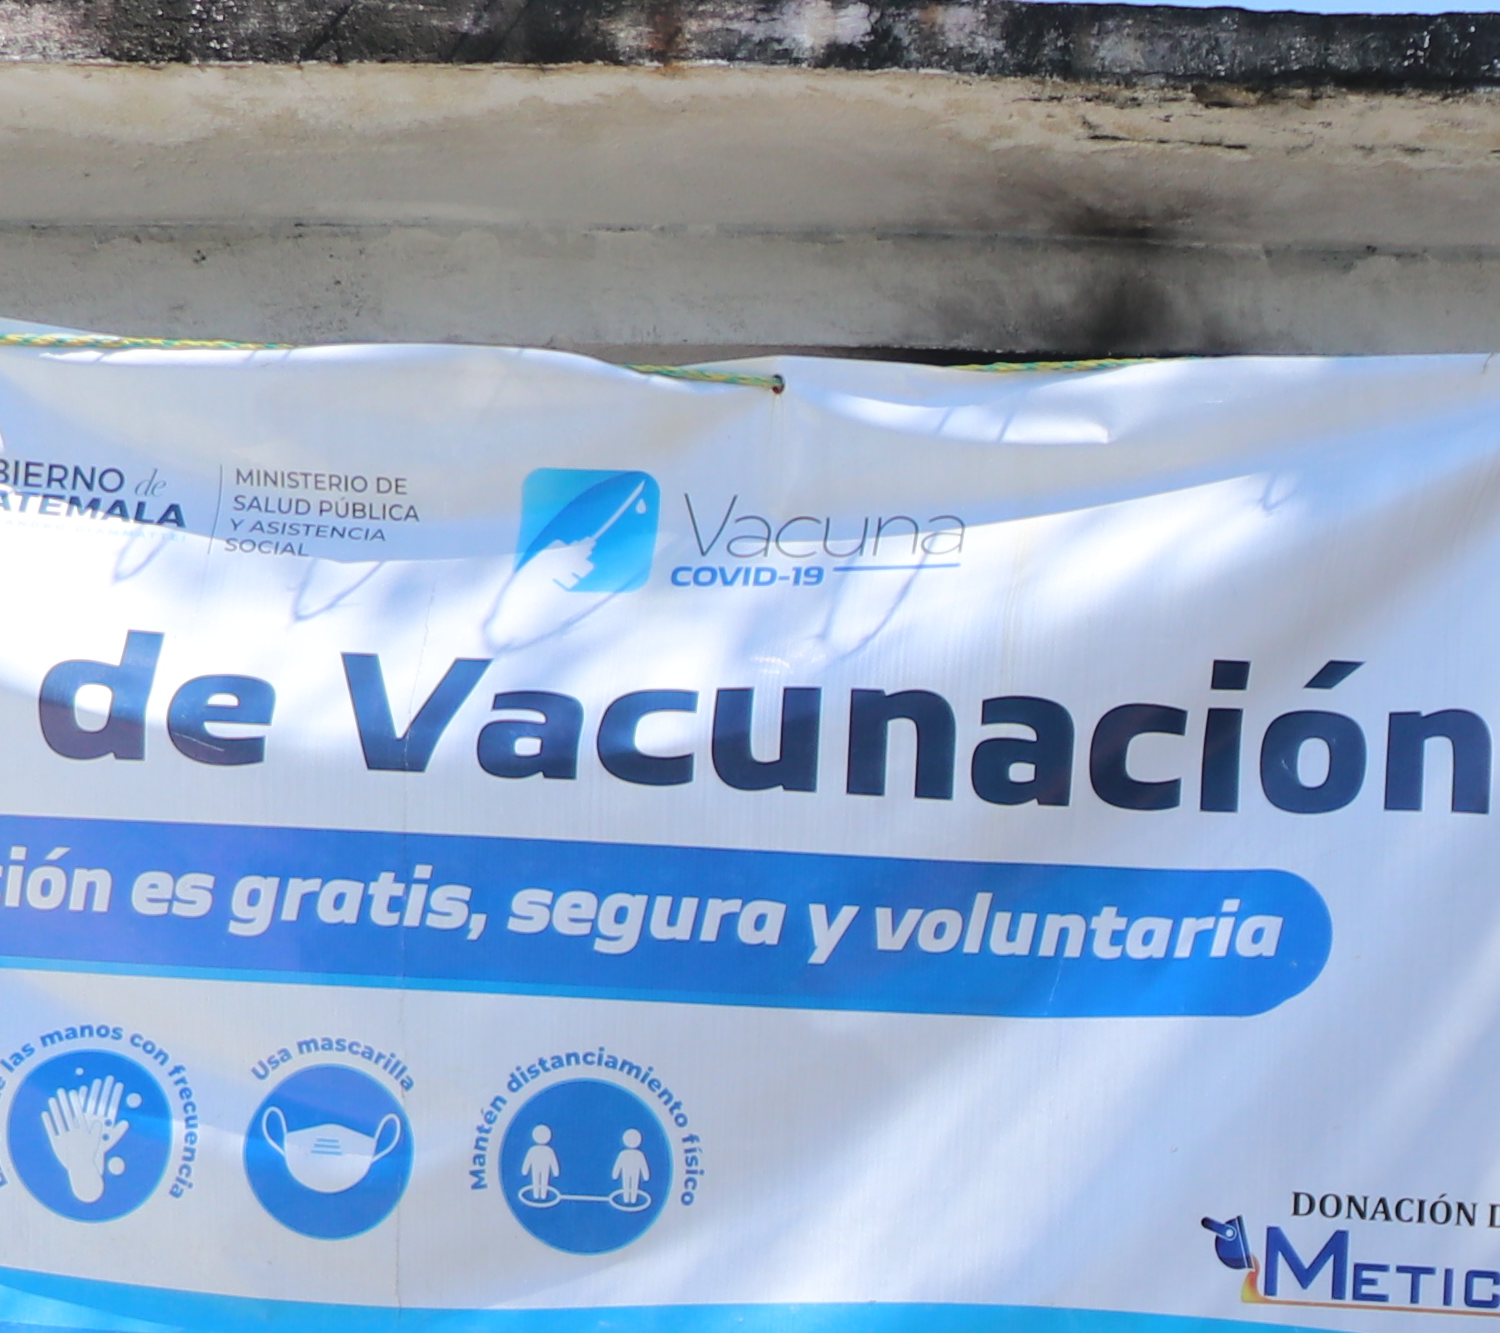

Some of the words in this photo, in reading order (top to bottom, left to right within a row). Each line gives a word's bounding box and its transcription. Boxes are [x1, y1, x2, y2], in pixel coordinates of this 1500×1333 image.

[134, 467, 167, 498] de
[235, 468, 369, 494] MINISTERIO
[376, 475, 409, 496] DE
[232, 494, 312, 517] SALUD
[318, 496, 421, 523] PÚBLICA
[684, 493, 967, 558] Vacuna
[224, 537, 311, 558] SOCIAL
[229, 517, 245, 534] Y
[249, 519, 387, 542] ASISTENCIA
[671, 566, 825, 588] COVID-19
[38, 629, 277, 767] de
[340, 651, 1495, 816] Vacunación
[131, 866, 214, 918] es
[229, 863, 491, 939] gratis,
[505, 885, 787, 956] segura
[805, 902, 861, 966] y
[874, 892, 1285, 959] voluntaria
[250, 1050, 294, 1082] Usa
[296, 1036, 416, 1093] mascarilla
[0, 1041, 36, 1073] las
[40, 1022, 124, 1049] manos
[128, 1032, 170, 1067] con
[167, 1063, 200, 1200] frecuencia
[468, 1095, 509, 1192] Mantén
[506, 1046, 689, 1129] distanciamiento
[679, 1132, 706, 1207] físico
[1291, 1191, 1477, 1228] DONACIÓN
